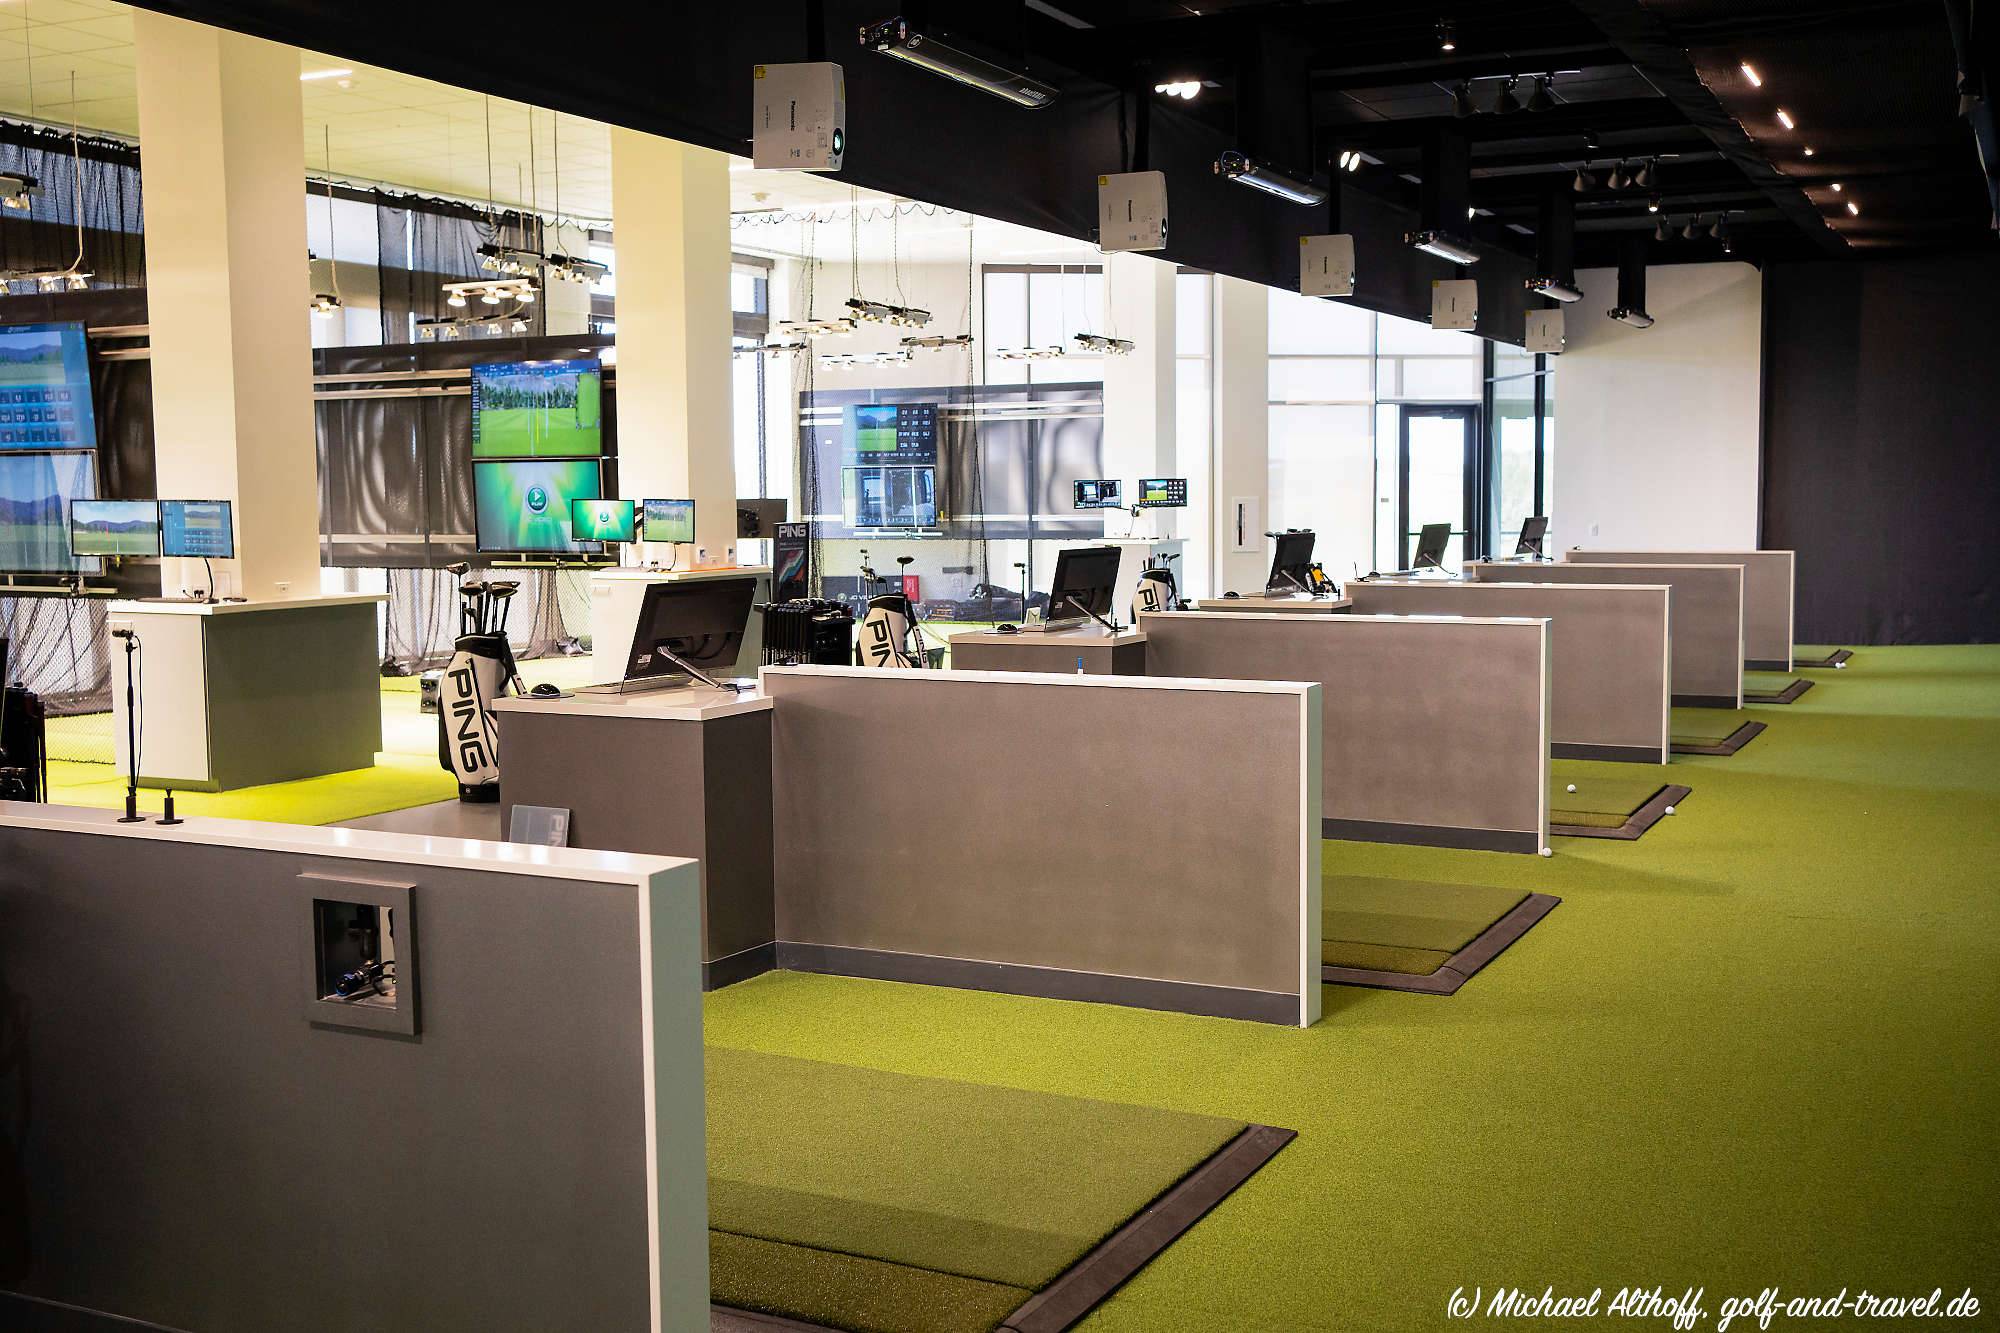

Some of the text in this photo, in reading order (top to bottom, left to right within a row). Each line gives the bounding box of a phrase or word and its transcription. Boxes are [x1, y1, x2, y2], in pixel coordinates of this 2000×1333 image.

[778, 525, 807, 539] PING
[866, 619, 891, 667] PIN
[447, 667, 489, 774] PING
